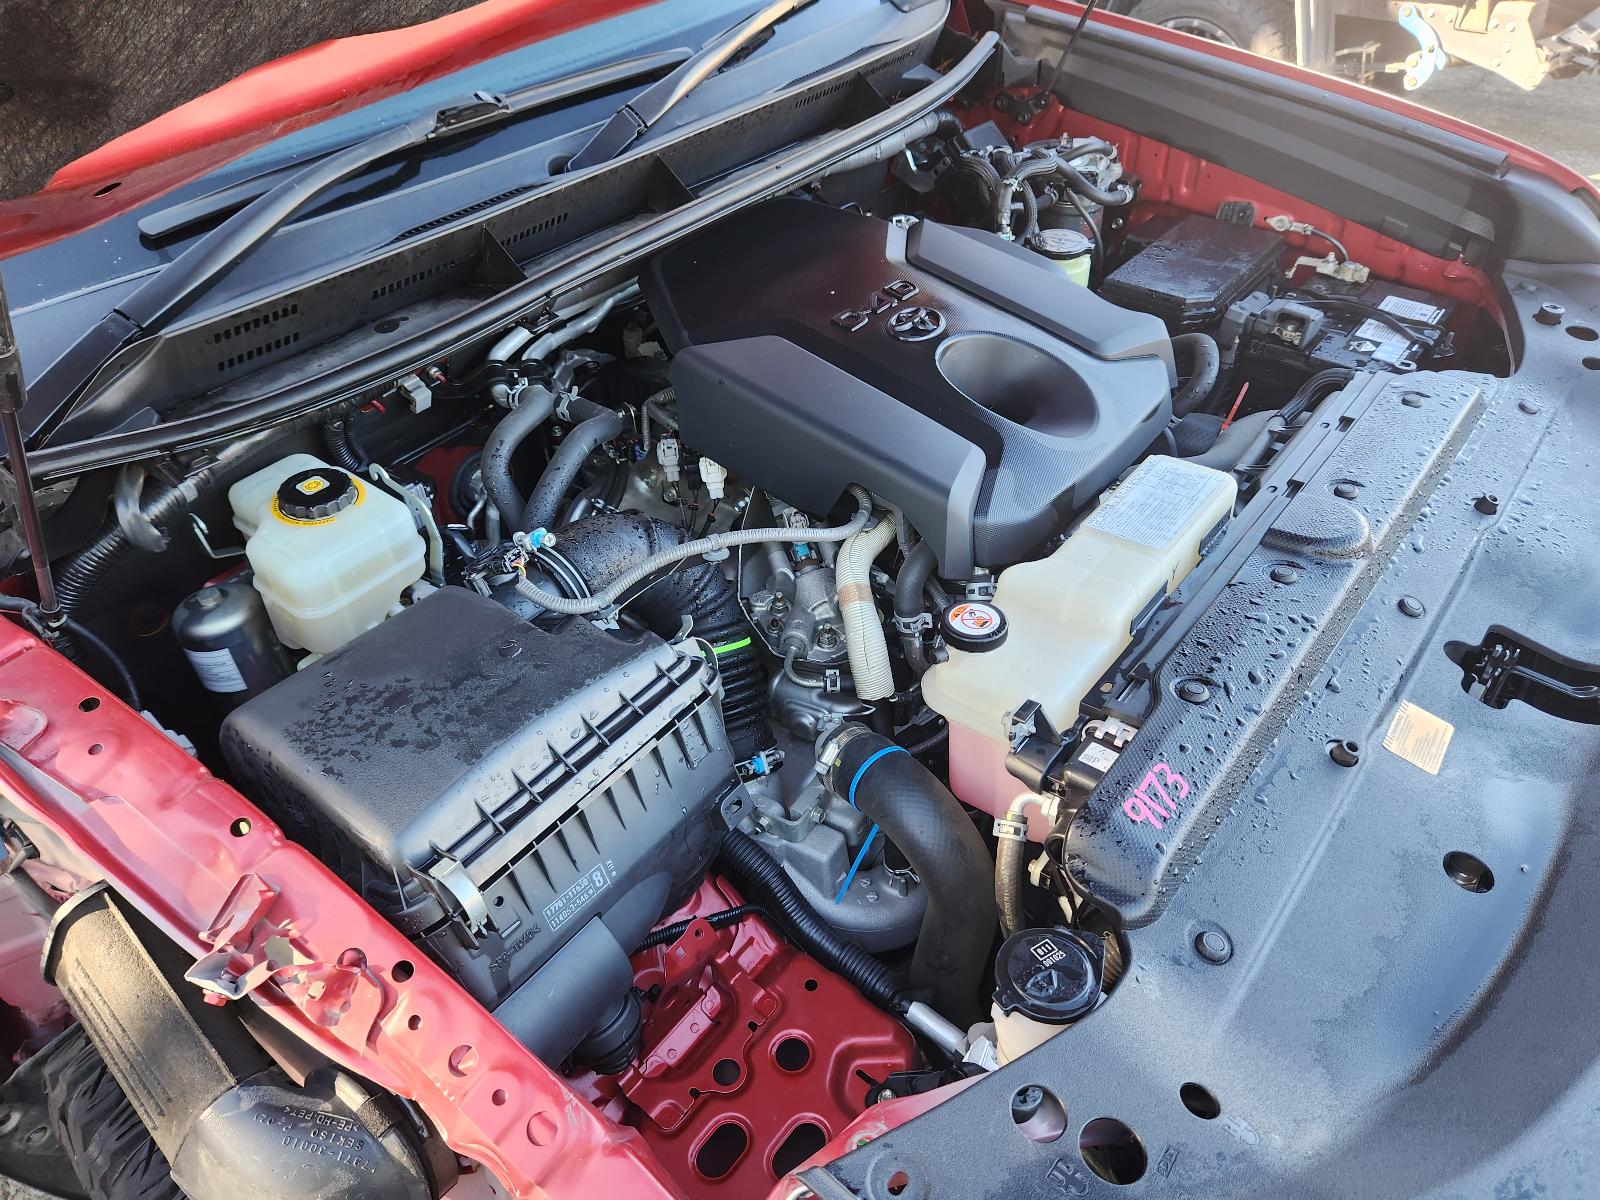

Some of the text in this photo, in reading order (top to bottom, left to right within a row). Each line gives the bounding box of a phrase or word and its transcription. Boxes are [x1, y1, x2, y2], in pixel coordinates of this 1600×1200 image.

[1123, 763, 1190, 830] 9173
[592, 870, 604, 888] 8
[310, 1128, 364, 1151] SEKISO
